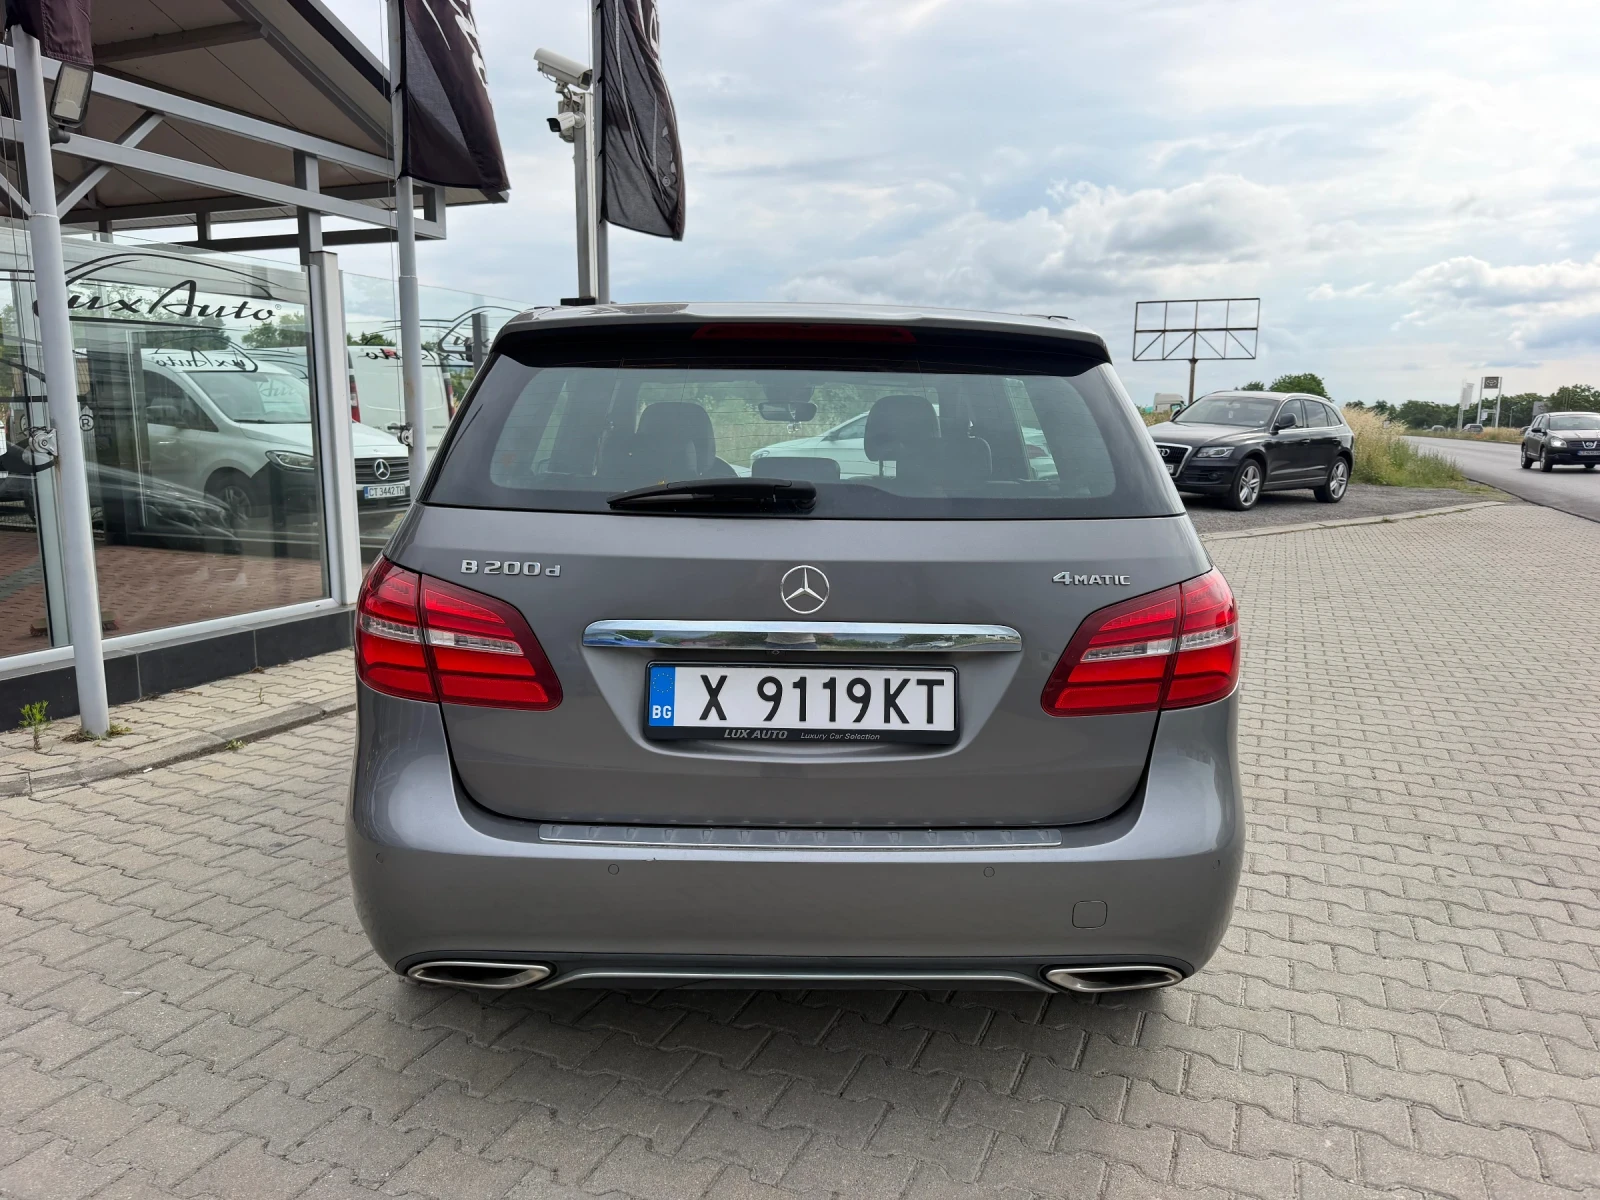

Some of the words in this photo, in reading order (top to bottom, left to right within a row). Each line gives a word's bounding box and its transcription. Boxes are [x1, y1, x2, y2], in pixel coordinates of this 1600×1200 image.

[461, 560, 478, 574] B
[484, 561, 540, 576] 200
[545, 565, 560, 577] d
[1052, 571, 1131, 586] 4MATIC
[699, 675, 728, 720] X
[652, 705, 672, 719] BG
[724, 729, 750, 739] LUX
[751, 730, 788, 740] AUTO
[800, 732, 827, 741] Luxury
[829, 733, 843, 741] Car
[844, 733, 881, 741] Selection
